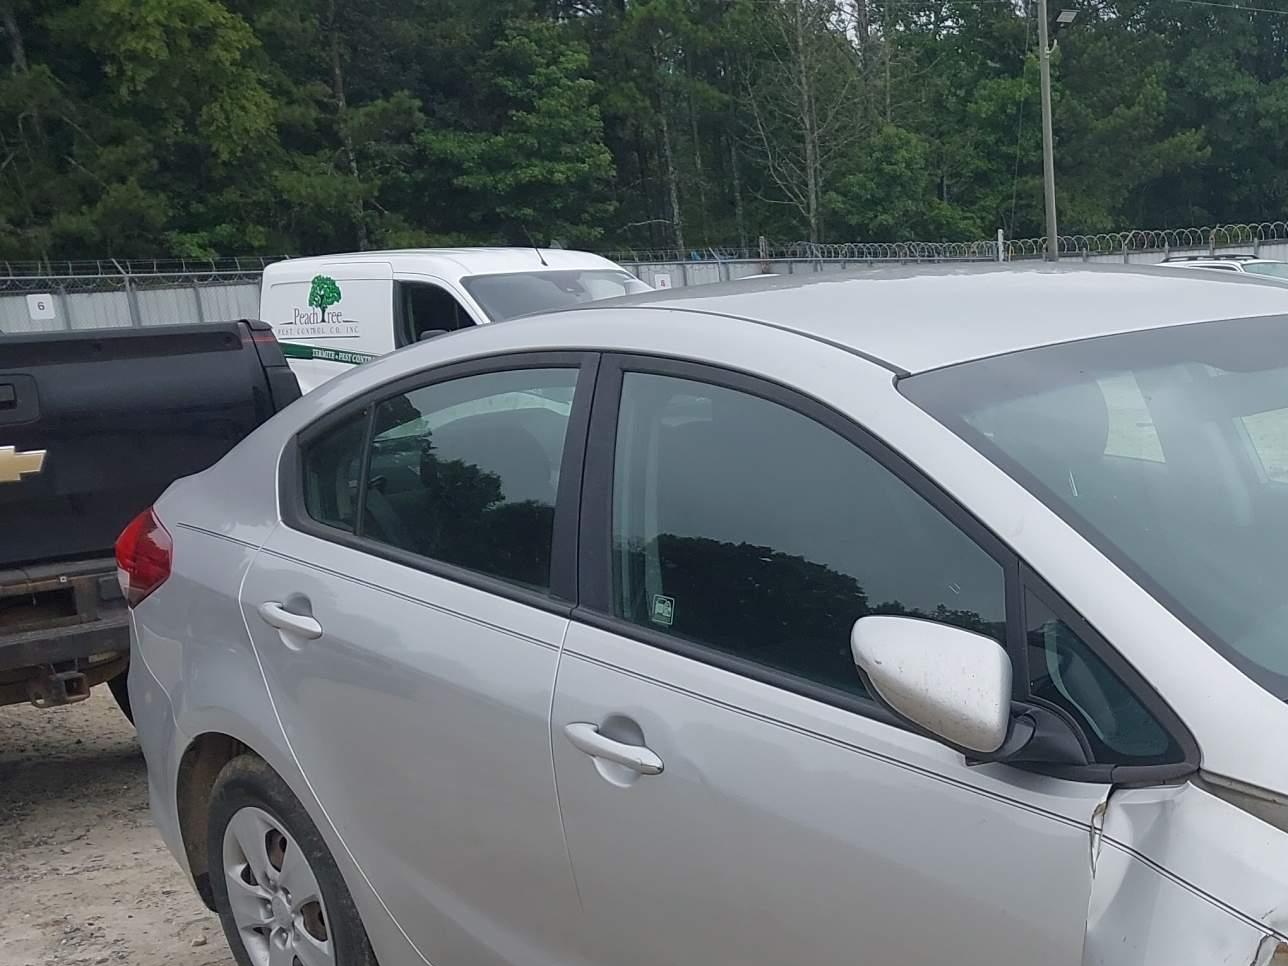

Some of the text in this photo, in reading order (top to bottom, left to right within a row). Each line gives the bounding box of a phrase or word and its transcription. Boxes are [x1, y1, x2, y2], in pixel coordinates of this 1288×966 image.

[37, 301, 45, 311] 6
[294, 308, 319, 325] Peach
[312, 349, 335, 359] TERMITE
[338, 352, 352, 362] PEST
